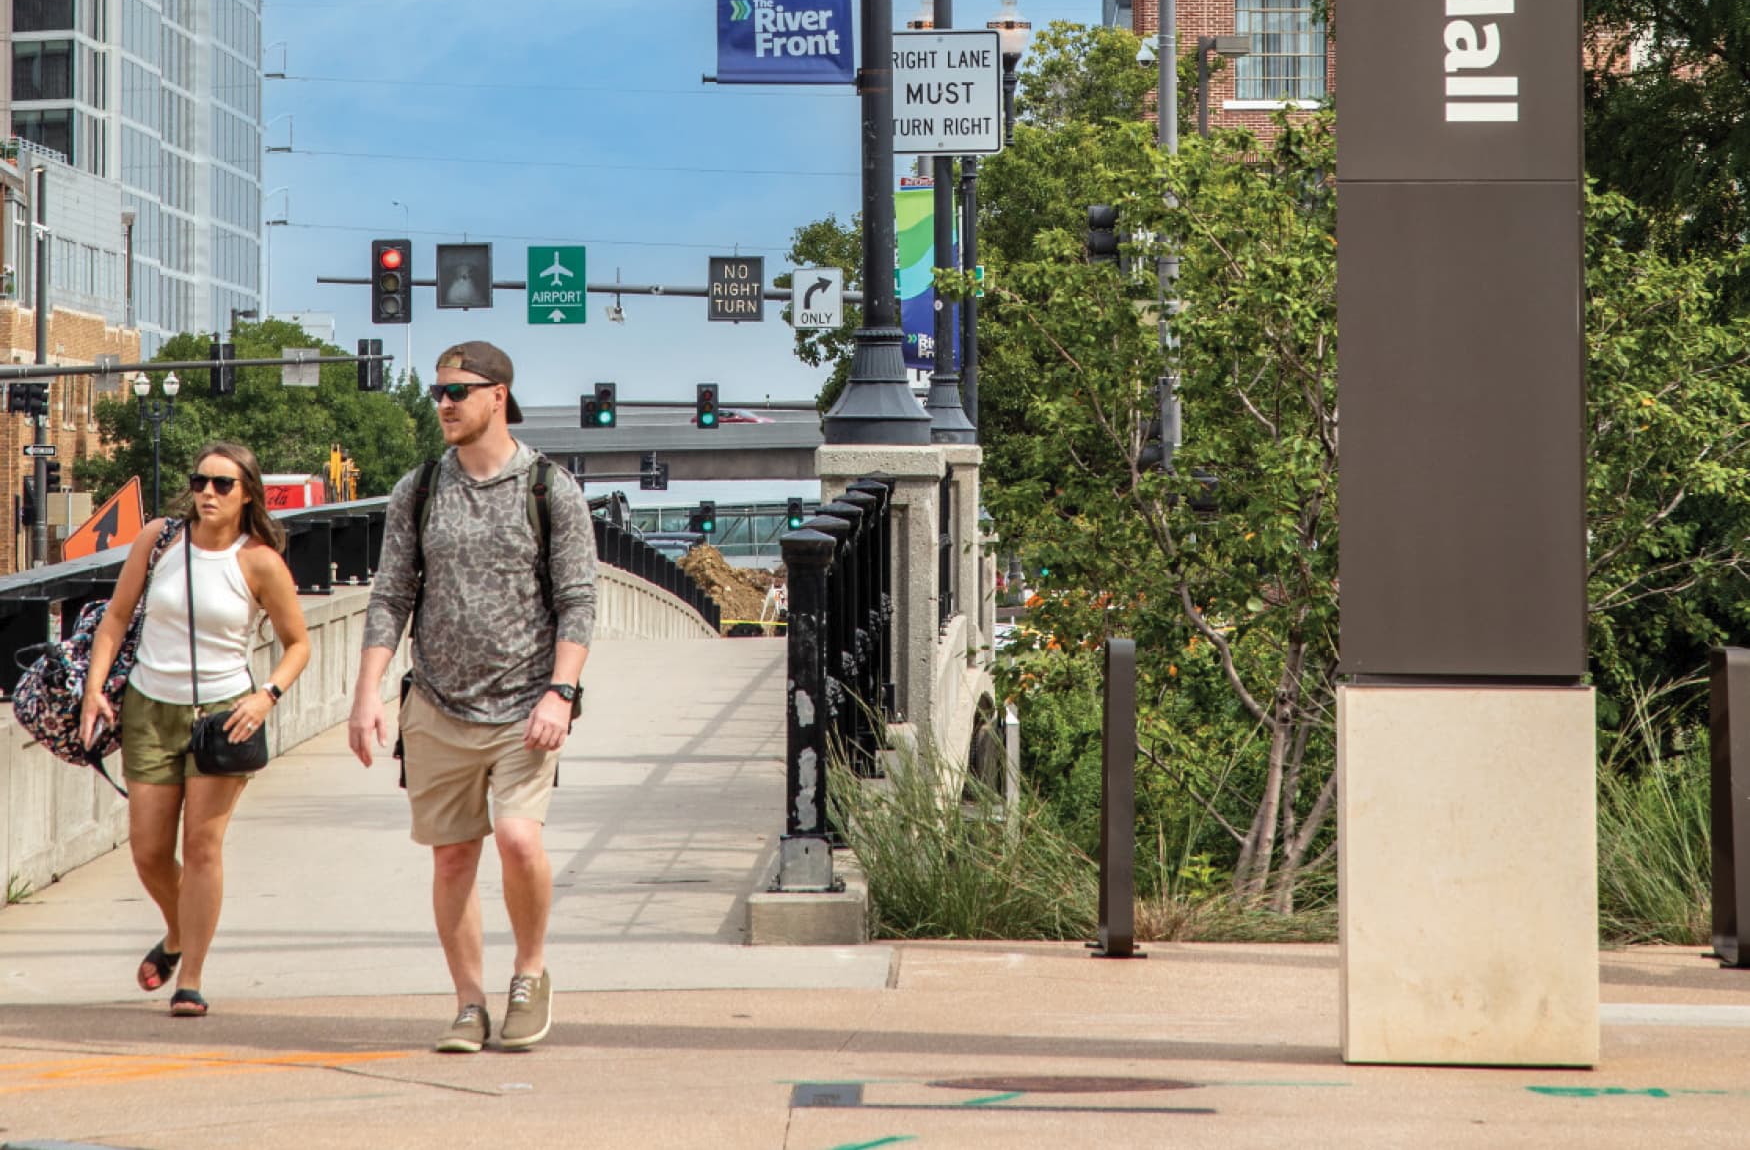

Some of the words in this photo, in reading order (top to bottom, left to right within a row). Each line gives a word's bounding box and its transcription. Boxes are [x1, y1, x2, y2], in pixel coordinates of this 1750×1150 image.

[754, 4, 833, 33] River
[755, 29, 841, 58] Front
[892, 51, 938, 69] RIGHT
[947, 50, 991, 68] LANE
[906, 82, 974, 105] MUST
[943, 117, 992, 136] RIGHT
[724, 265, 749, 280] NO
[531, 291, 582, 303] AIRPORT
[713, 282, 760, 296] RIGHT
[715, 299, 757, 314] TURN
[801, 313, 833, 324] ONLY
